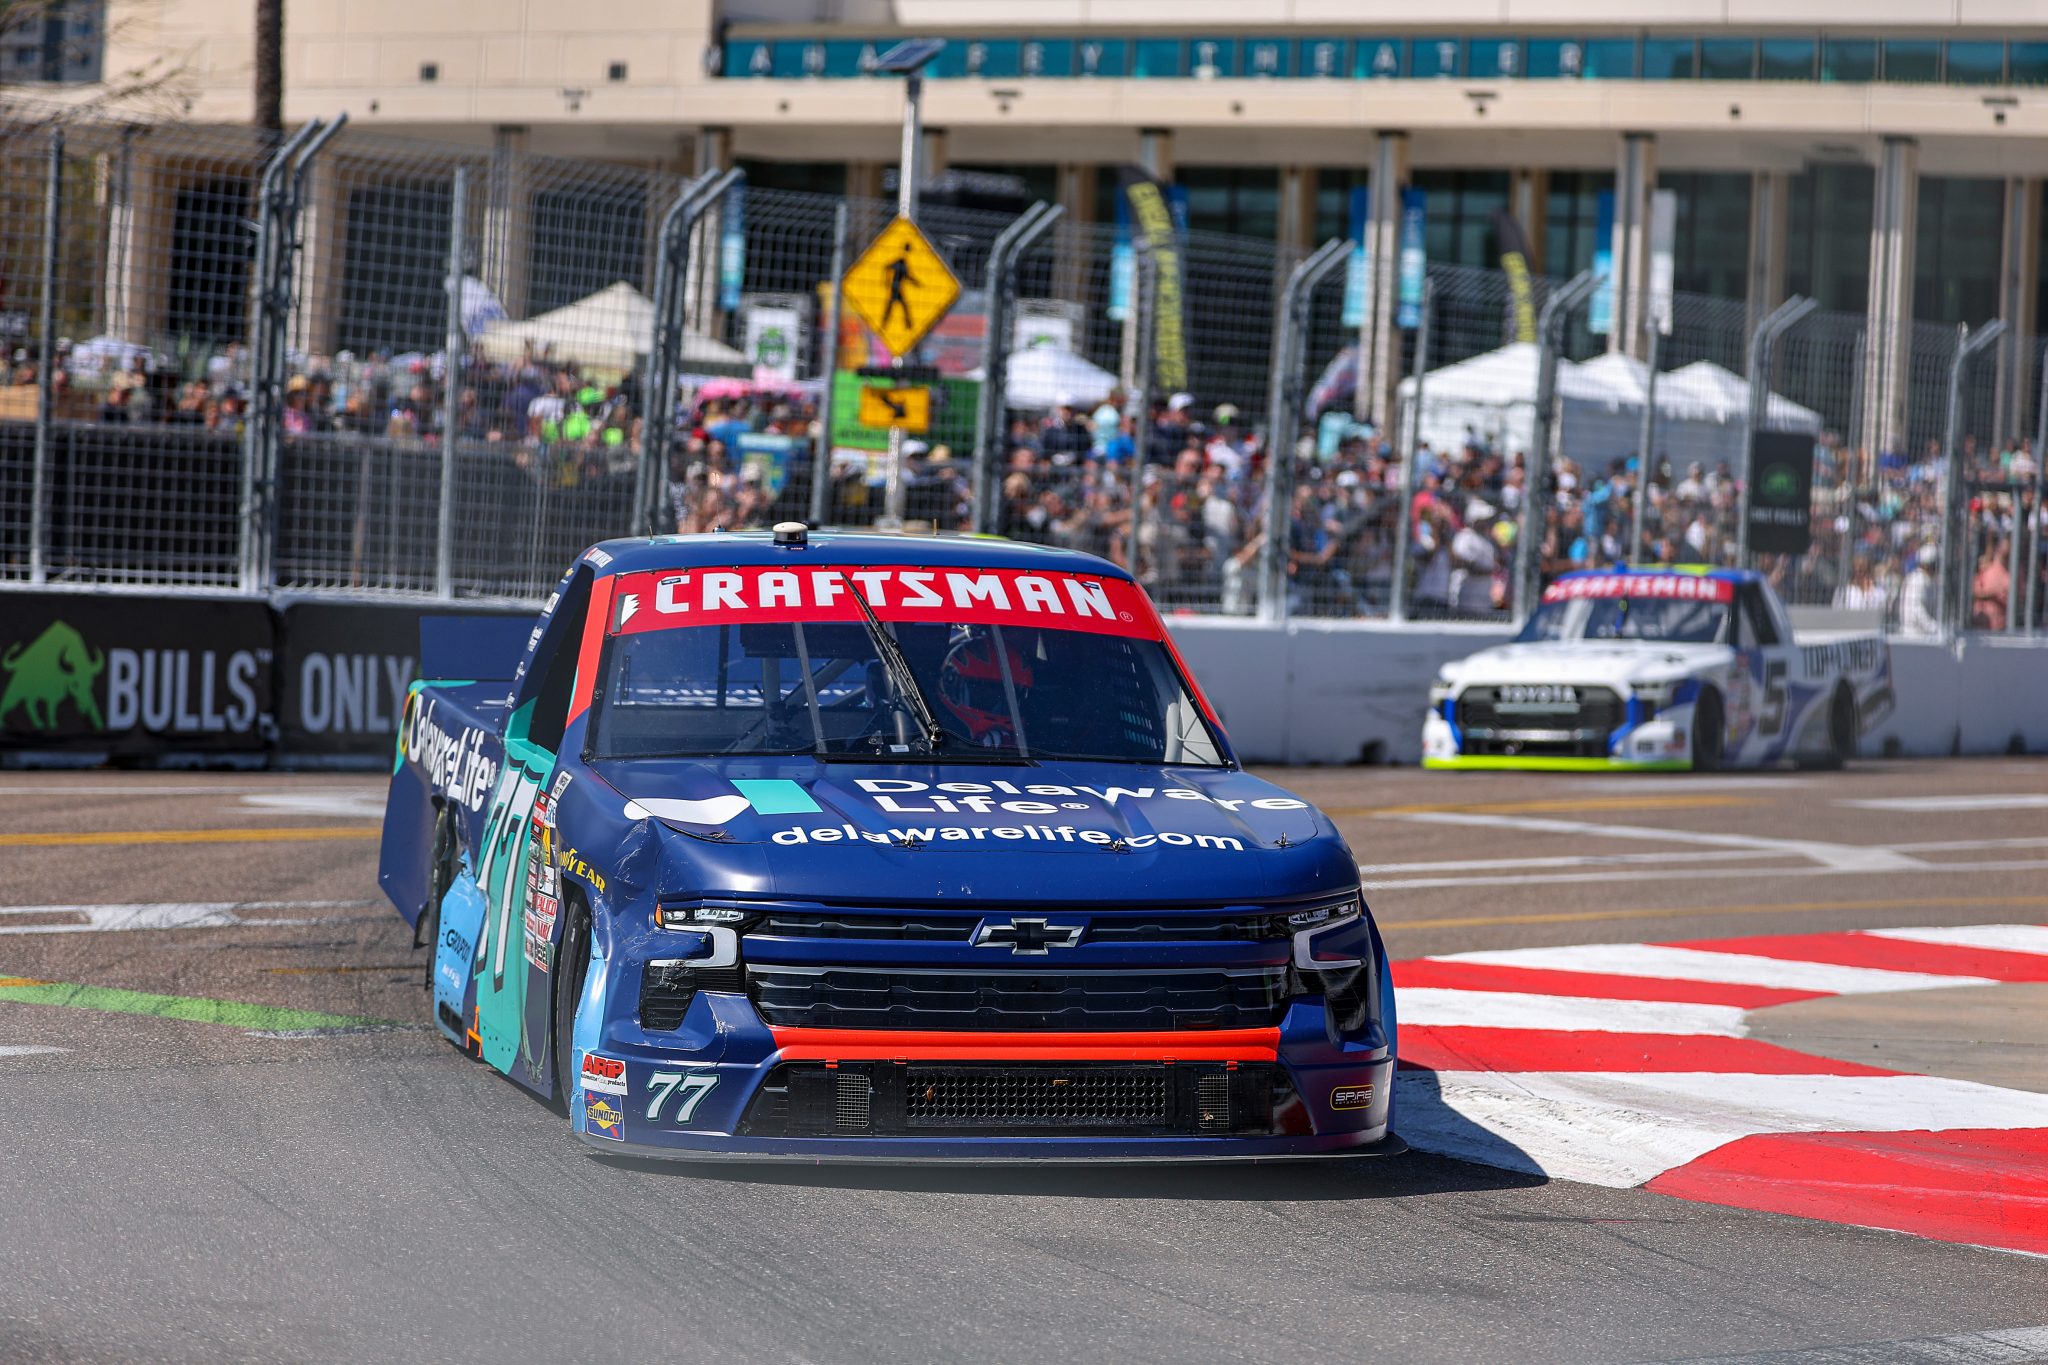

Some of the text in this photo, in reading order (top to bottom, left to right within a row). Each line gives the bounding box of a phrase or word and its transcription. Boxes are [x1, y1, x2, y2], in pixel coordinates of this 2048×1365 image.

[1196, 42, 1582, 73] THEATER
[656, 571, 1118, 620] CRAFTSMAN
[302, 652, 416, 734] ONLY
[1500, 685, 1577, 704] TOYOTA
[853, 779, 1309, 812] Delaware
[771, 823, 1245, 851] delawarelife.com
[582, 1054, 625, 1079] ARP
[646, 1070, 721, 1125] 77
[588, 1107, 621, 1124] SUNOCO
